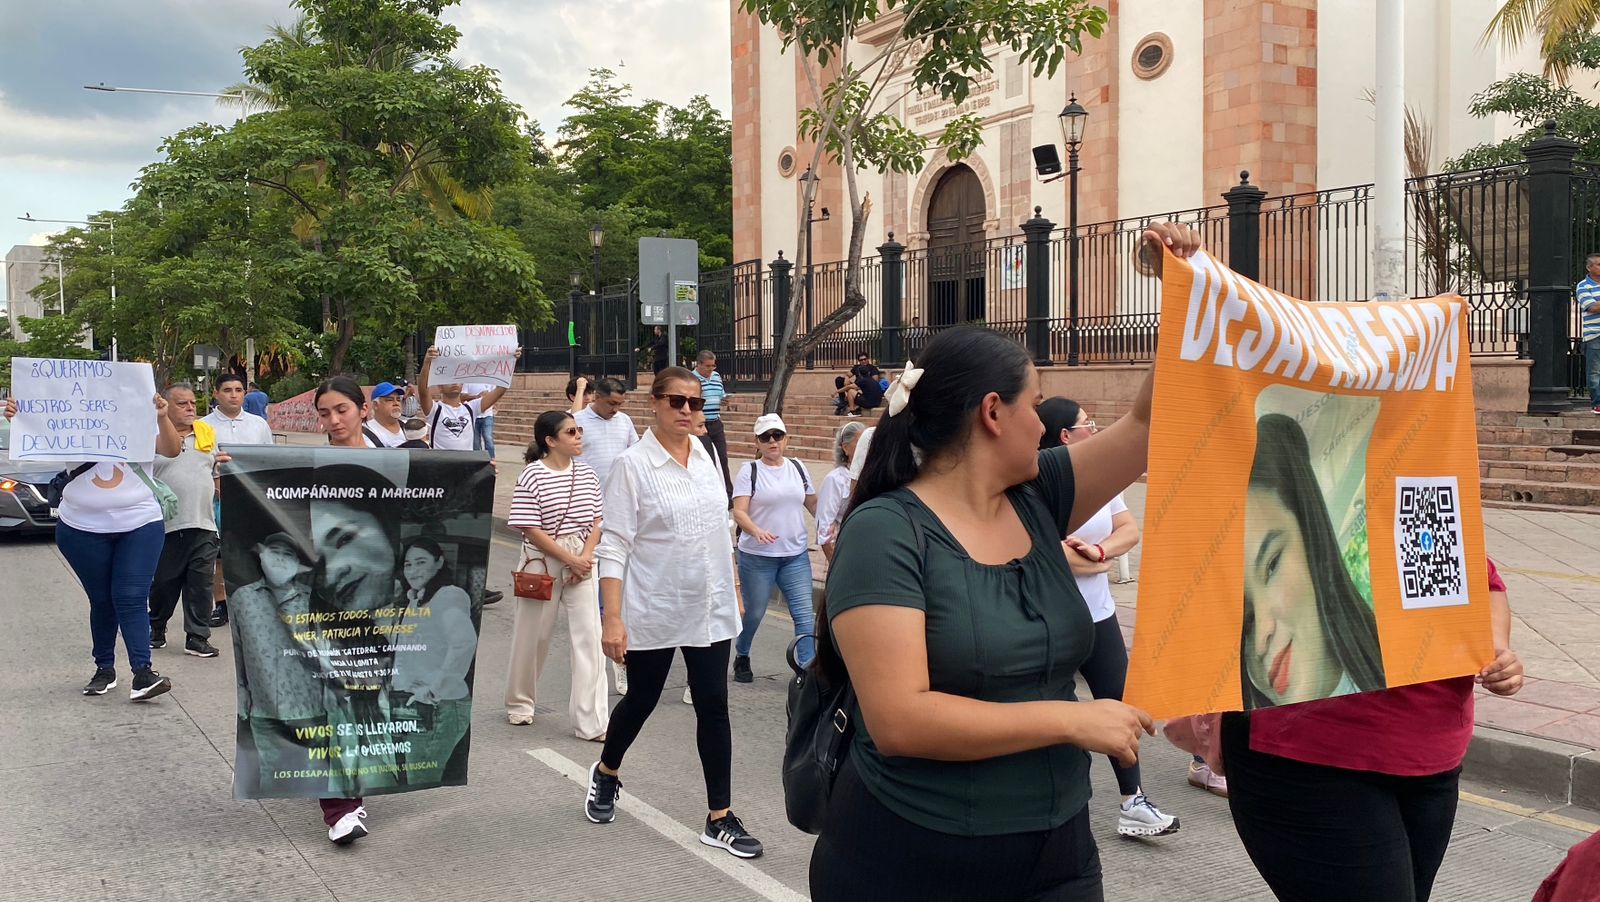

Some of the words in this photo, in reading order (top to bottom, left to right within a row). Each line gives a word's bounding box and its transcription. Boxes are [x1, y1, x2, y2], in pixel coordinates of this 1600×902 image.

[454, 344, 466, 357] SE
[434, 365, 448, 376] SE
[454, 359, 512, 377] BUSCAN
[71, 382, 84, 396] A
[16, 399, 72, 414] NUESTROS
[80, 399, 117, 413] SERES
[47, 418, 109, 432] QUERIDOS
[22, 434, 127, 452] DEVUELTA!
[266, 484, 364, 499] ACOMPÁÑANOS
[368, 487, 378, 498] A
[382, 487, 445, 499] MARCHAR
[296, 612, 336, 624] ESTAMOS
[338, 609, 372, 623] TODOS,
[374, 607, 396, 619] NOS
[398, 606, 432, 619] FALTA
[322, 626, 361, 640] PATRICIA
[364, 626, 370, 637] Y
[382, 643, 427, 652] CAMINANDO
[296, 724, 333, 740] VIVOS
[337, 722, 353, 737] SE
[308, 746, 341, 760] VIVOS
[361, 741, 412, 757] QUEREMOS
[274, 770, 291, 779] LOS
[409, 761, 438, 771] BUSCAN
